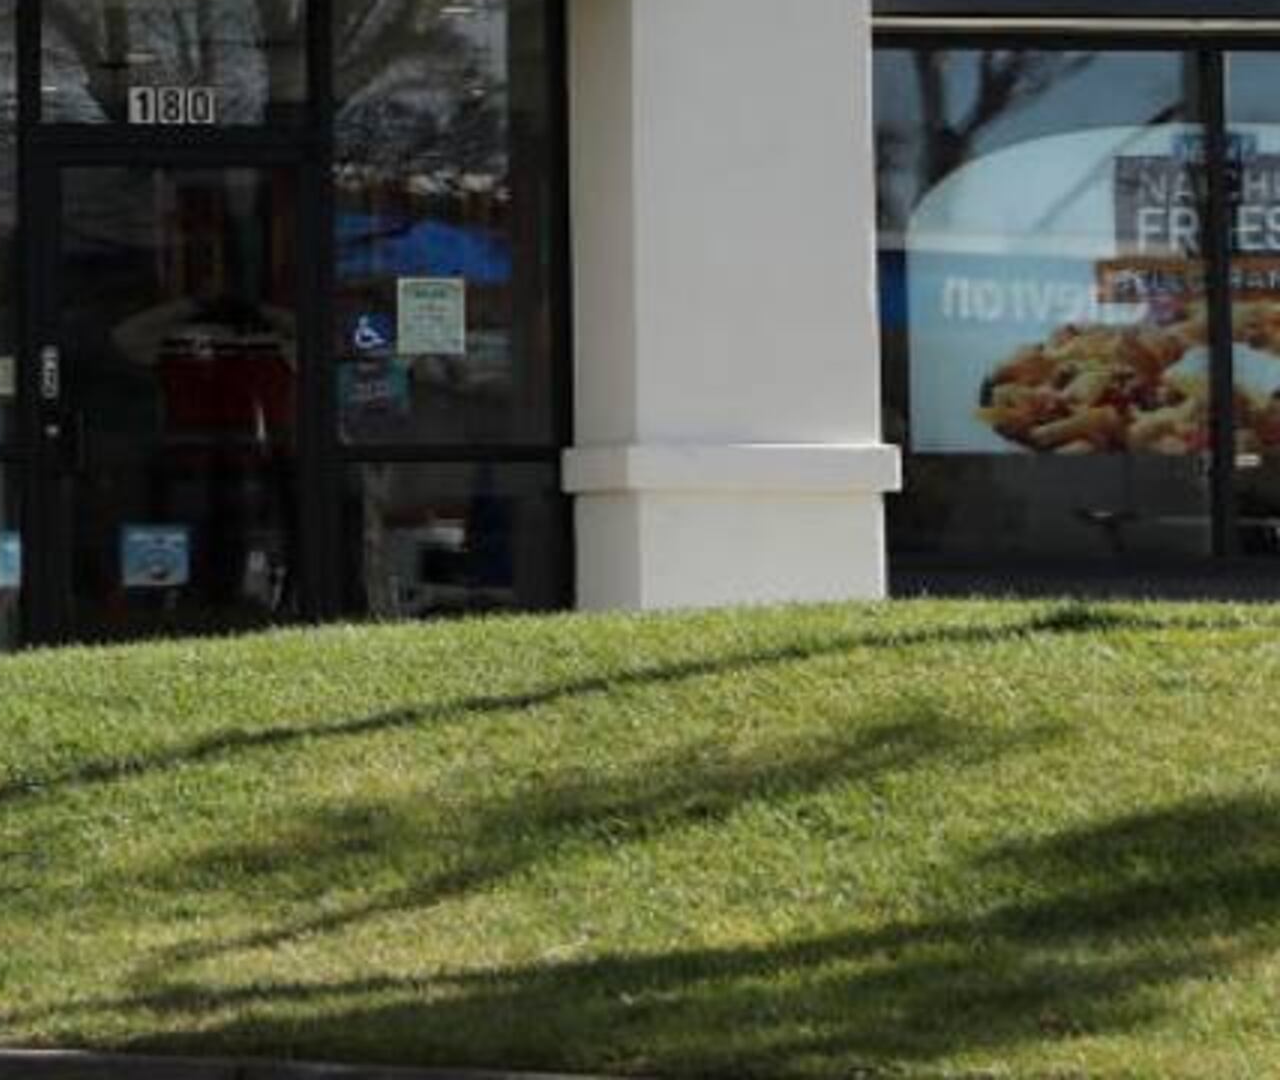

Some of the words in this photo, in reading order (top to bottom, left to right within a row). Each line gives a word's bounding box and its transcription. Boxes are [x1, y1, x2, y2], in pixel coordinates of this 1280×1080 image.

[135, 89, 210, 121] 180
[1135, 168, 1280, 204] NAH
[1137, 206, 1280, 251] FRE
